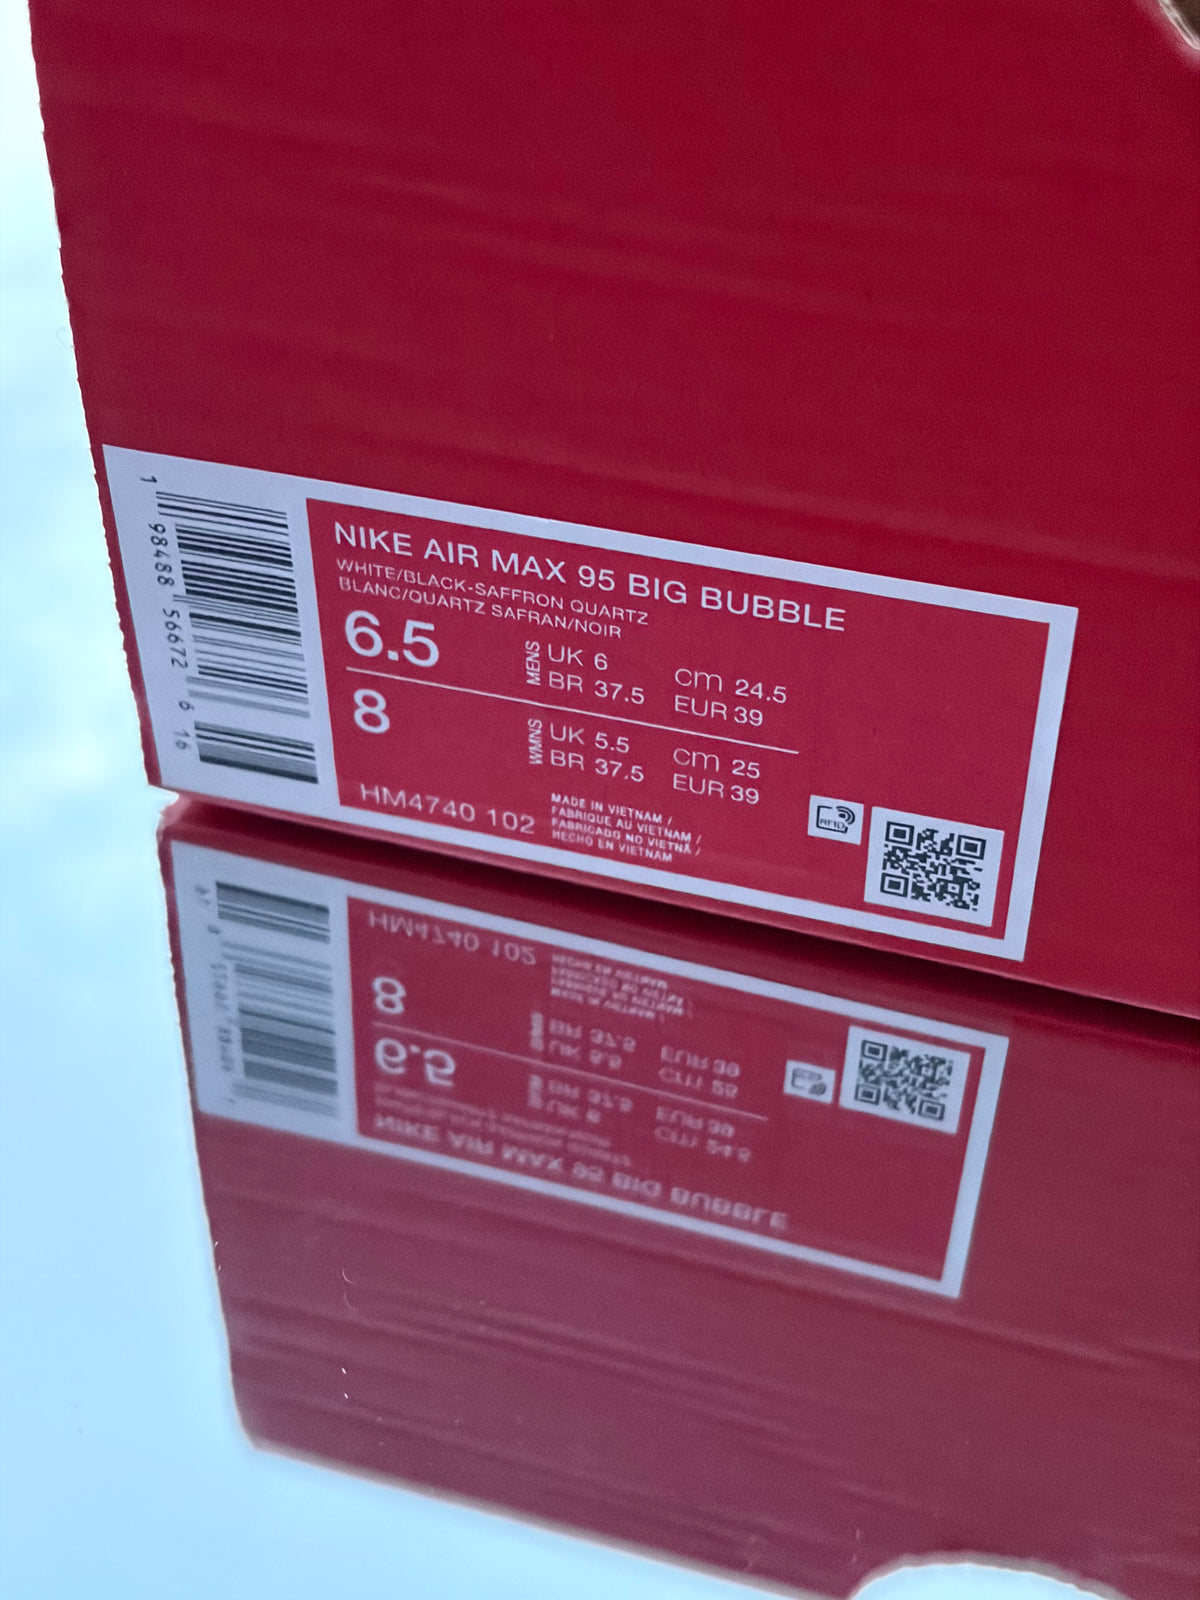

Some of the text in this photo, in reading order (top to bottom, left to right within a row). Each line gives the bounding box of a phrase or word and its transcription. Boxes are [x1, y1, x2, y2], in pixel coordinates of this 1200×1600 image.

[139, 475, 195, 712] 1 98488 56672 6
[335, 522, 846, 632] NIKE AIR MAX 95 BIG BUBBLE
[336, 558, 648, 626] WHITE/BLACK-SAFFRON QUARTZ
[339, 576, 621, 639] BLANC/QUARTZ SAFRAN/NOIR
[344, 609, 440, 668] 6.5
[525, 640, 541, 686] MENS
[548, 643, 608, 671] UK 6
[549, 671, 645, 705] BR 37.5
[735, 679, 787, 704] 24.5
[353, 688, 390, 734] 8
[675, 695, 763, 727] EUR 39
[528, 718, 543, 765] WMNS
[550, 723, 630, 753] UK 5.5
[550, 749, 645, 783] BR 37.5
[732, 759, 760, 779] 25
[673, 773, 760, 805] EUR 39
[360, 783, 536, 834] HM4740 102
[551, 793, 585, 808] MADE
[591, 800, 603, 812] IN
[608, 804, 662, 823] VIETNAM
[551, 805, 611, 827] FABRIQUE
[616, 819, 633, 831] AU
[637, 823, 692, 843] VIETNAM
[598, 838, 614, 851] EN
[619, 843, 673, 862] VIETNAM
